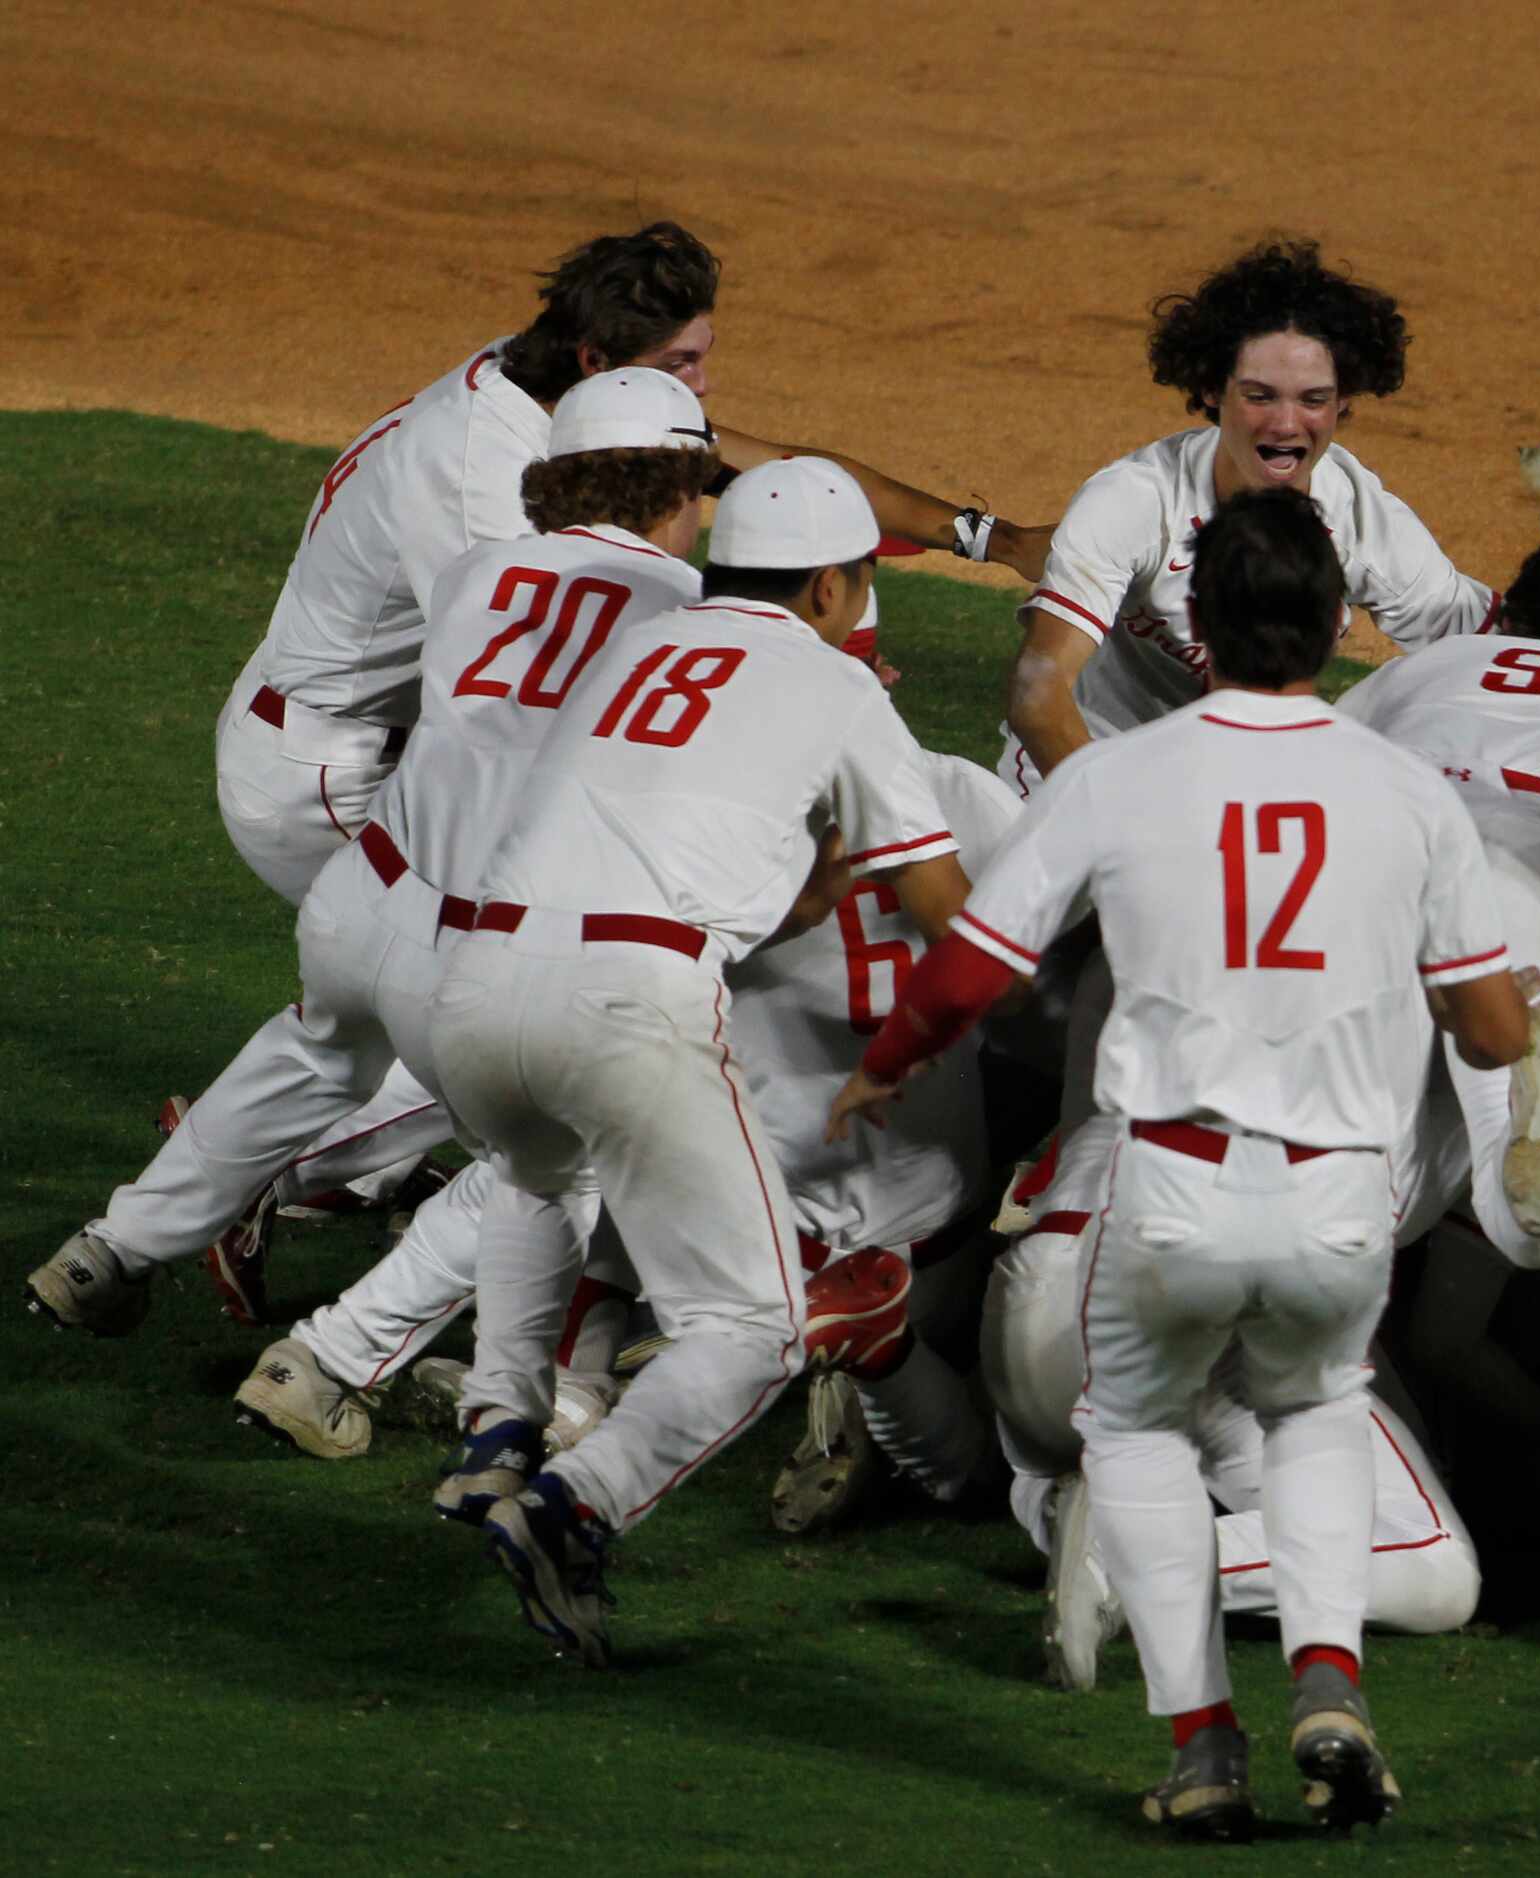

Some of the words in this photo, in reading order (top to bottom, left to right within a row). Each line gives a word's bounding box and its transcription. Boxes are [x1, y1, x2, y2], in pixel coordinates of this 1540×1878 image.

[453, 566, 632, 709] 20
[592, 643, 747, 748] 18
[836, 879, 913, 1035] 6
[1217, 801, 1327, 971] 12
